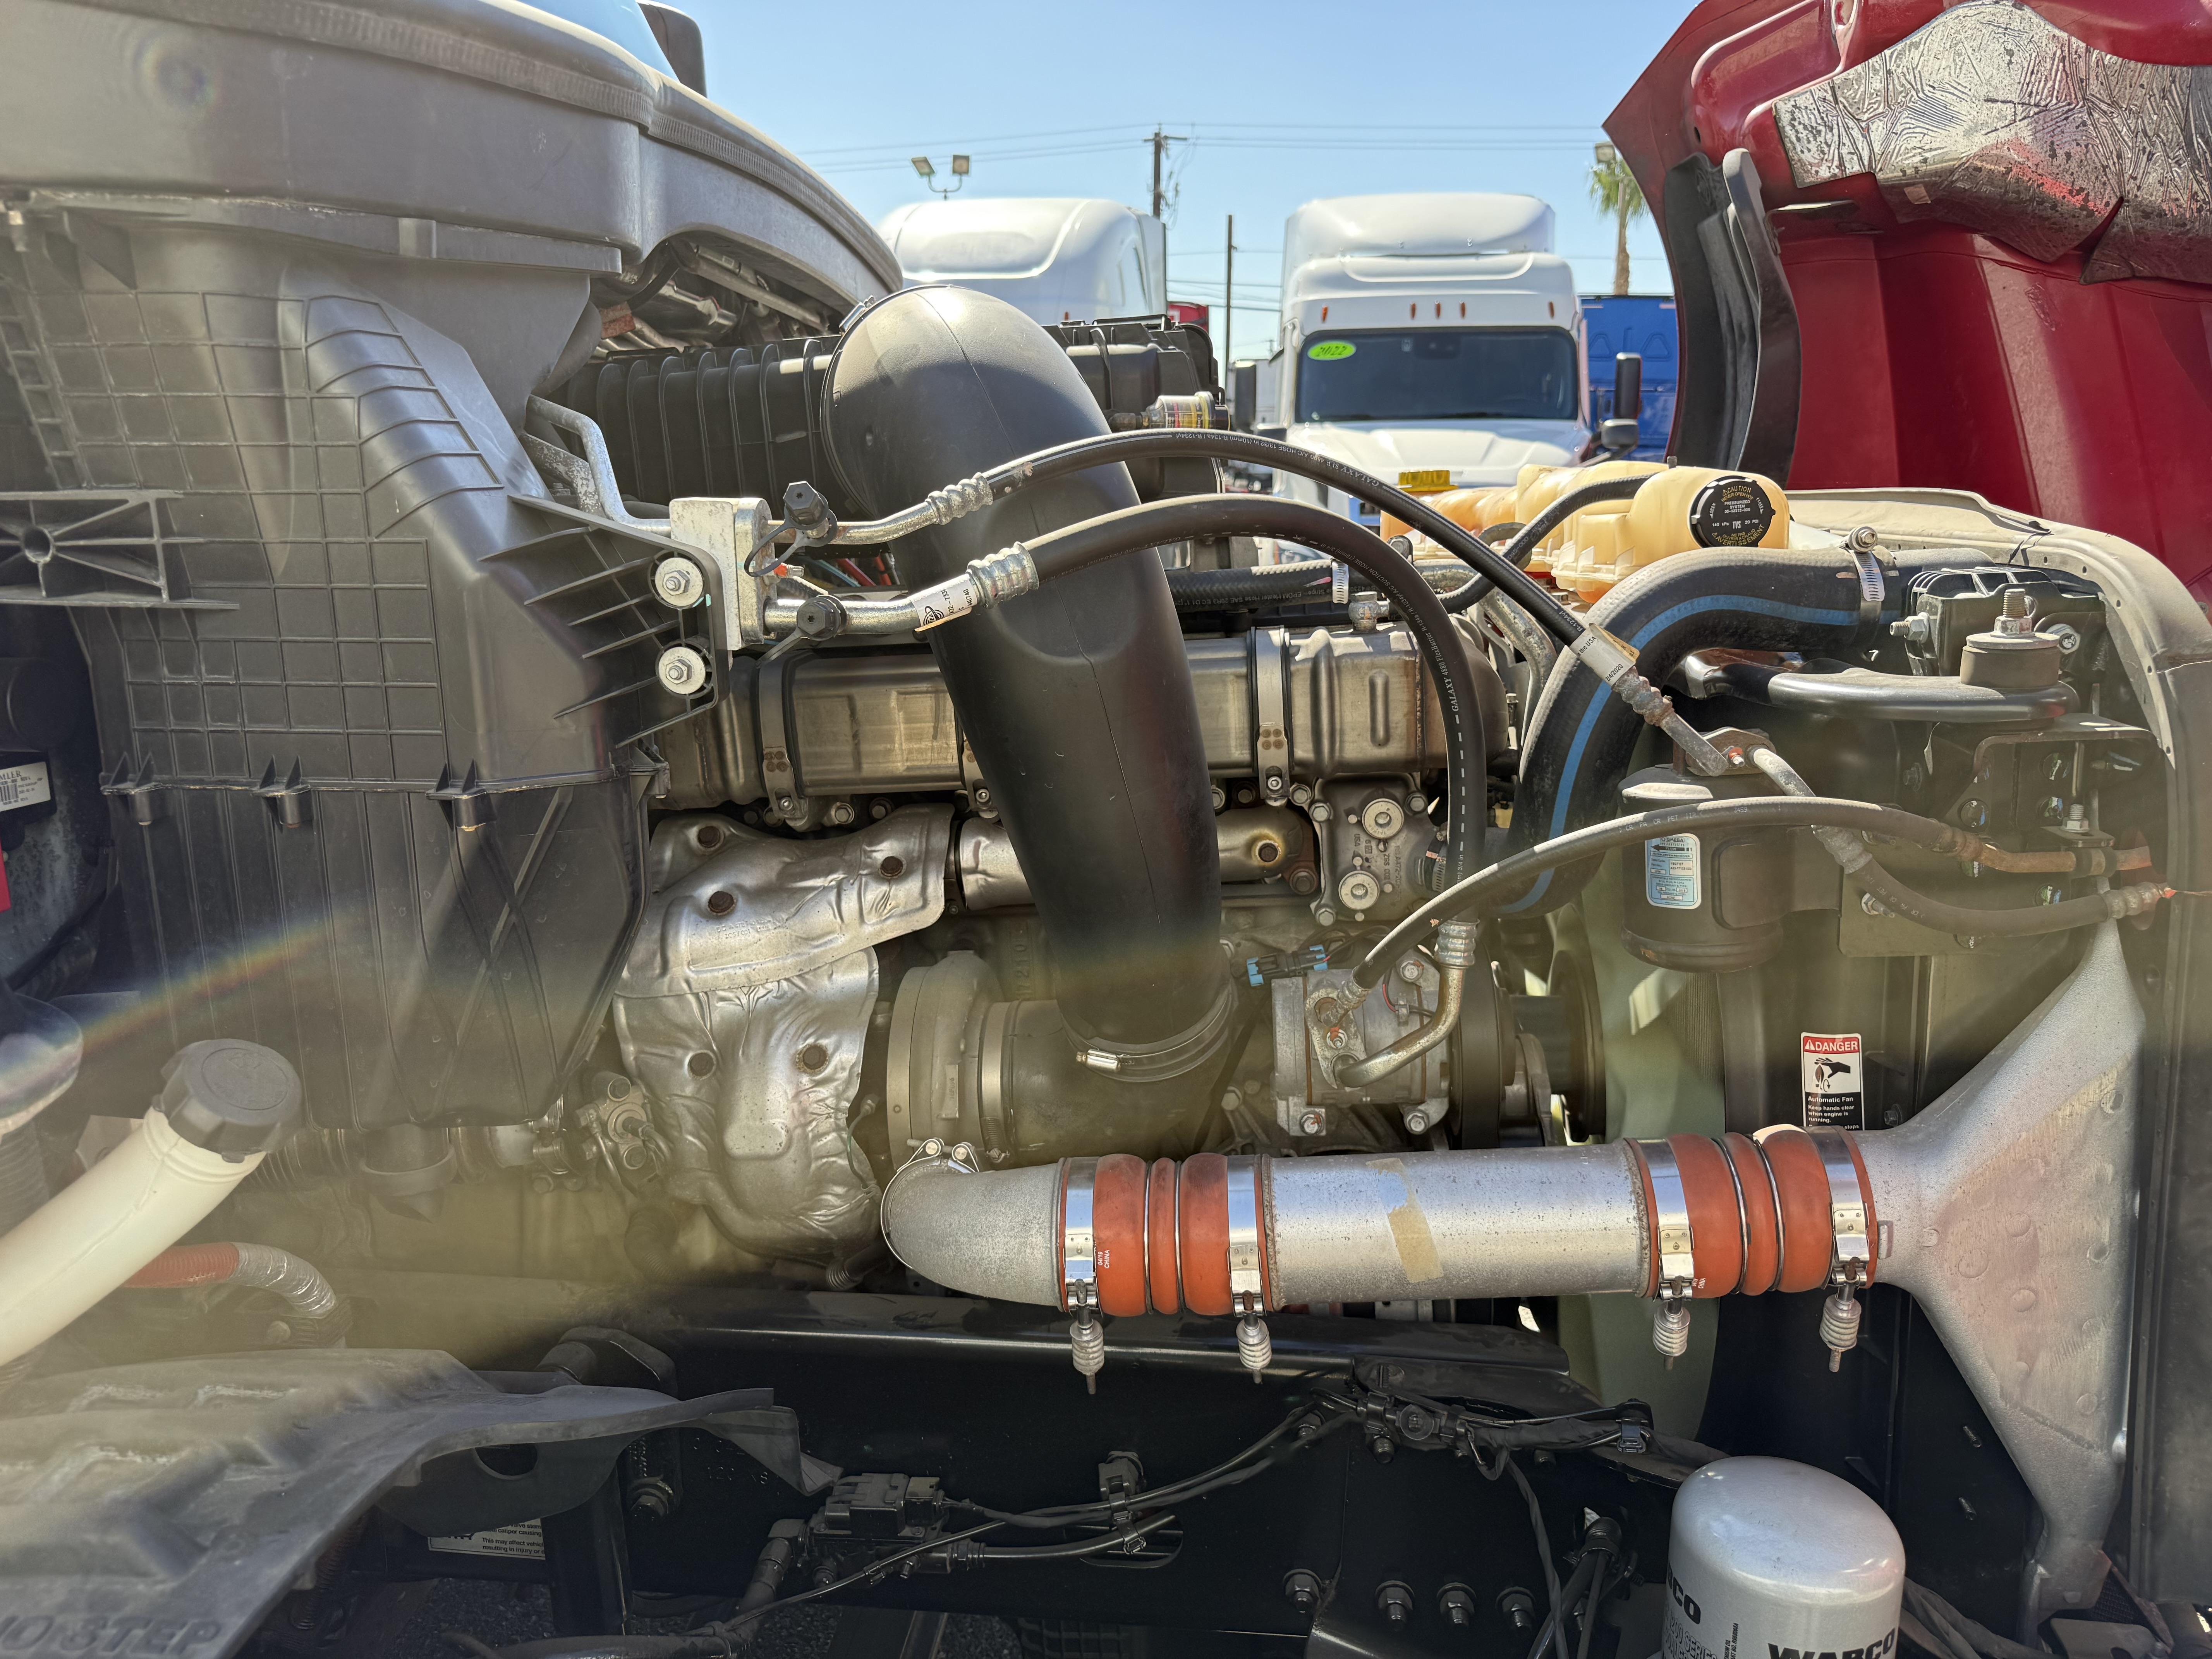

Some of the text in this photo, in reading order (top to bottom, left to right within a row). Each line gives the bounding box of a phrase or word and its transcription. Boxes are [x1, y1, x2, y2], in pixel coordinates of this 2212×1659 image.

[1230, 436, 1252, 444] (10mm)
[1278, 445, 1296, 454] HOSE
[1340, 466, 1379, 487] GALAXY
[1733, 520, 1741, 529] TVS
[1716, 524, 1765, 546] AVERTISSEMENT
[1355, 558, 1370, 570] HOSE
[1368, 568, 1390, 587] SUCTION
[1388, 585, 1398, 594] A/C
[1396, 593, 1414, 614] R-1234yf
[1414, 614, 1427, 632] R-134a
[1559, 611, 1583, 632] R-1234yf
[1425, 632, 1442, 662] FlexBarrier
[1579, 646, 1587, 655] the
[1586, 636, 1596, 646] USA
[1438, 662, 1449, 676] 4880
[1443, 677, 1459, 712] GALAXY
[1815, 1041, 1858, 1052] DANGER
